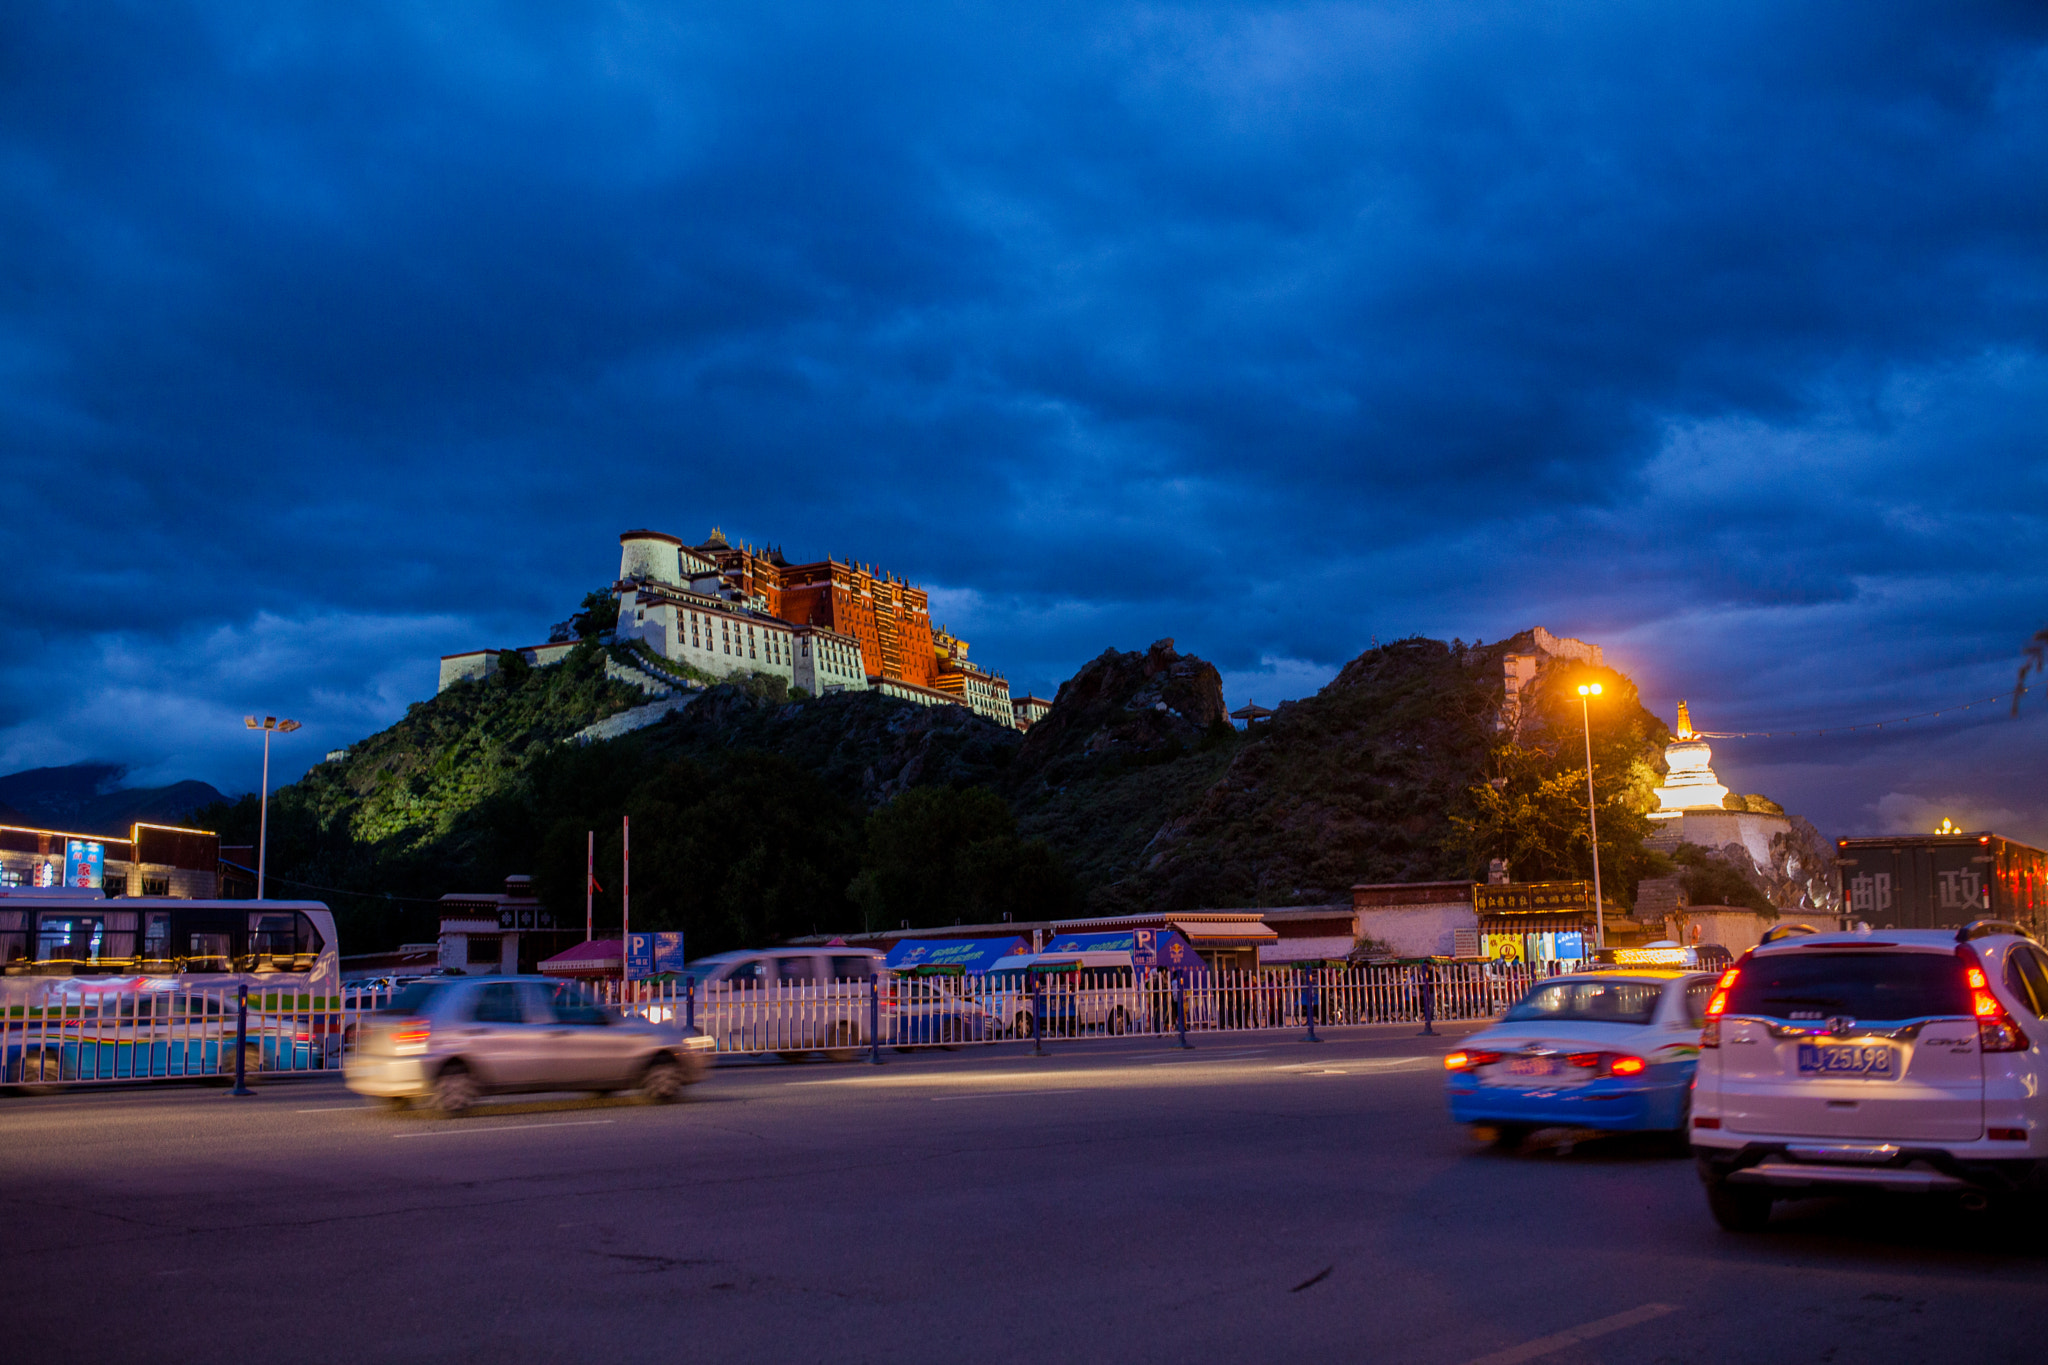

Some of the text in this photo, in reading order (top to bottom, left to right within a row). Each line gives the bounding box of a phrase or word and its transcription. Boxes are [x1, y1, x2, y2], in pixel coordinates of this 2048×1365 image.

[1850, 867, 1983, 912] 邮政
[633, 936, 644, 956] P
[1138, 931, 1151, 948] P
